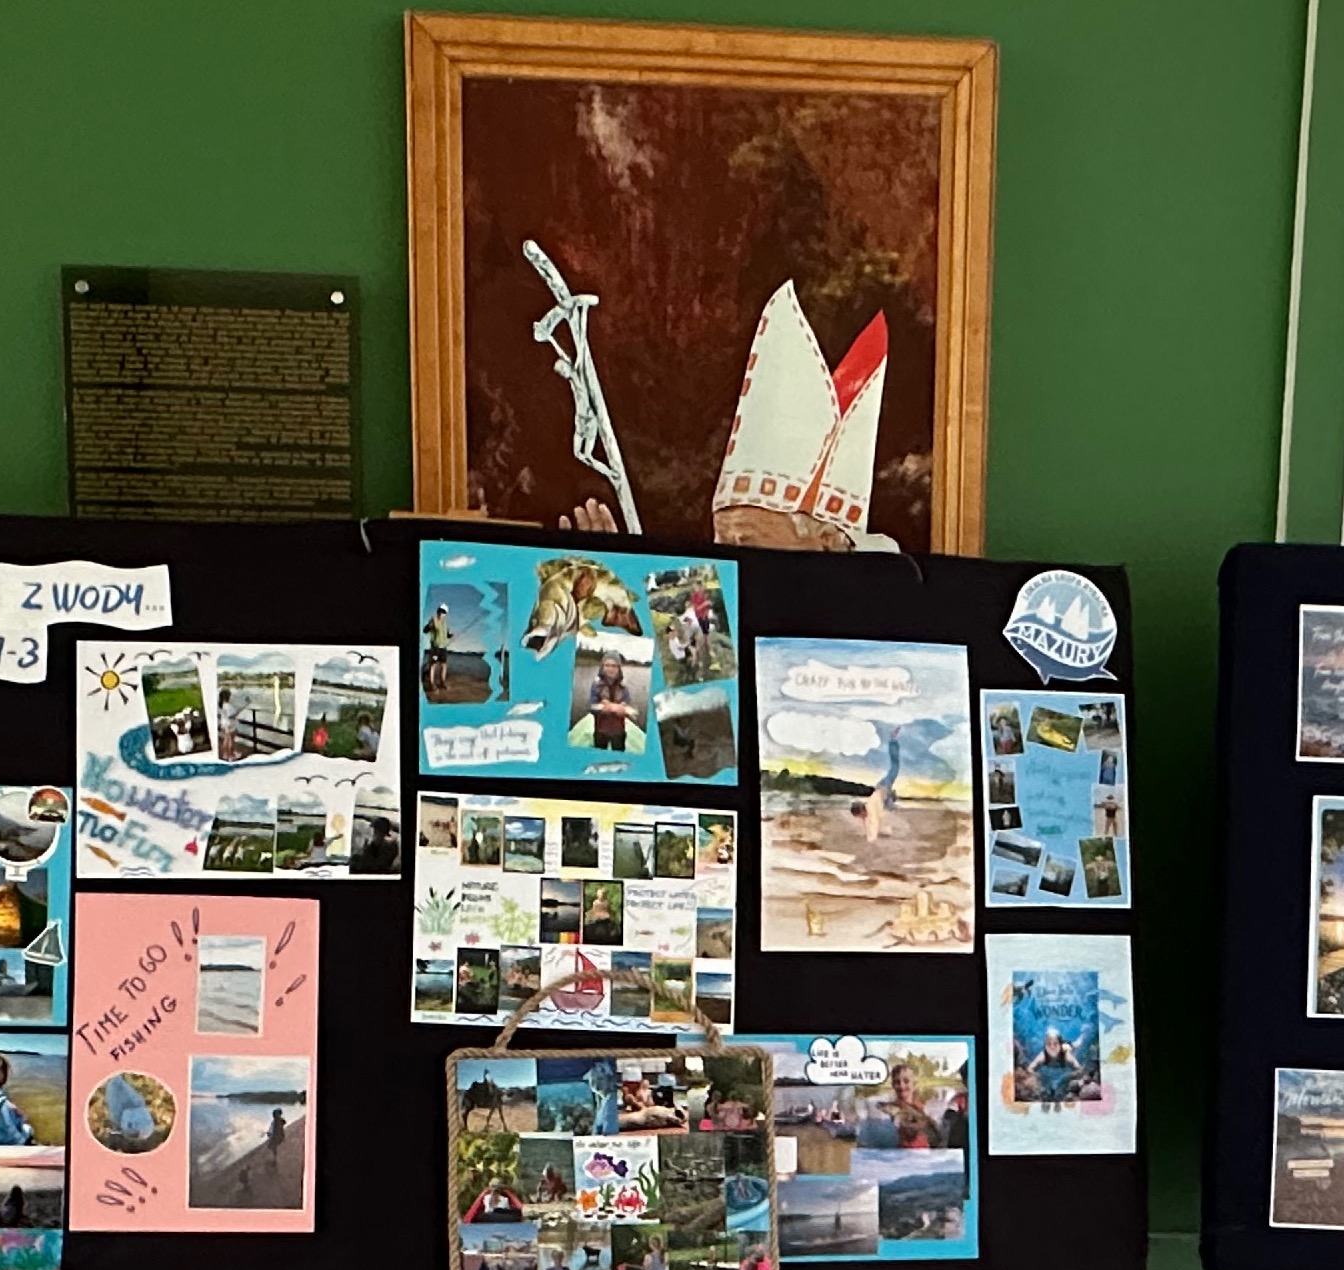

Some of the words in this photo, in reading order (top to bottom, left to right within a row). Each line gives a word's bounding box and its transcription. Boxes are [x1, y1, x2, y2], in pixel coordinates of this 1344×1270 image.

[21, 582, 44, 610] Z
[1018, 625, 1103, 665] MAZURY
[80, 751, 124, 804] No
[124, 788, 213, 832] water
[78, 809, 119, 842] no
[75, 1004, 130, 1056] TIME
[118, 976, 148, 1001] TO
[138, 944, 168, 975] GO
[109, 995, 178, 1062] FISHING
[850, 1071, 882, 1081] WATER
